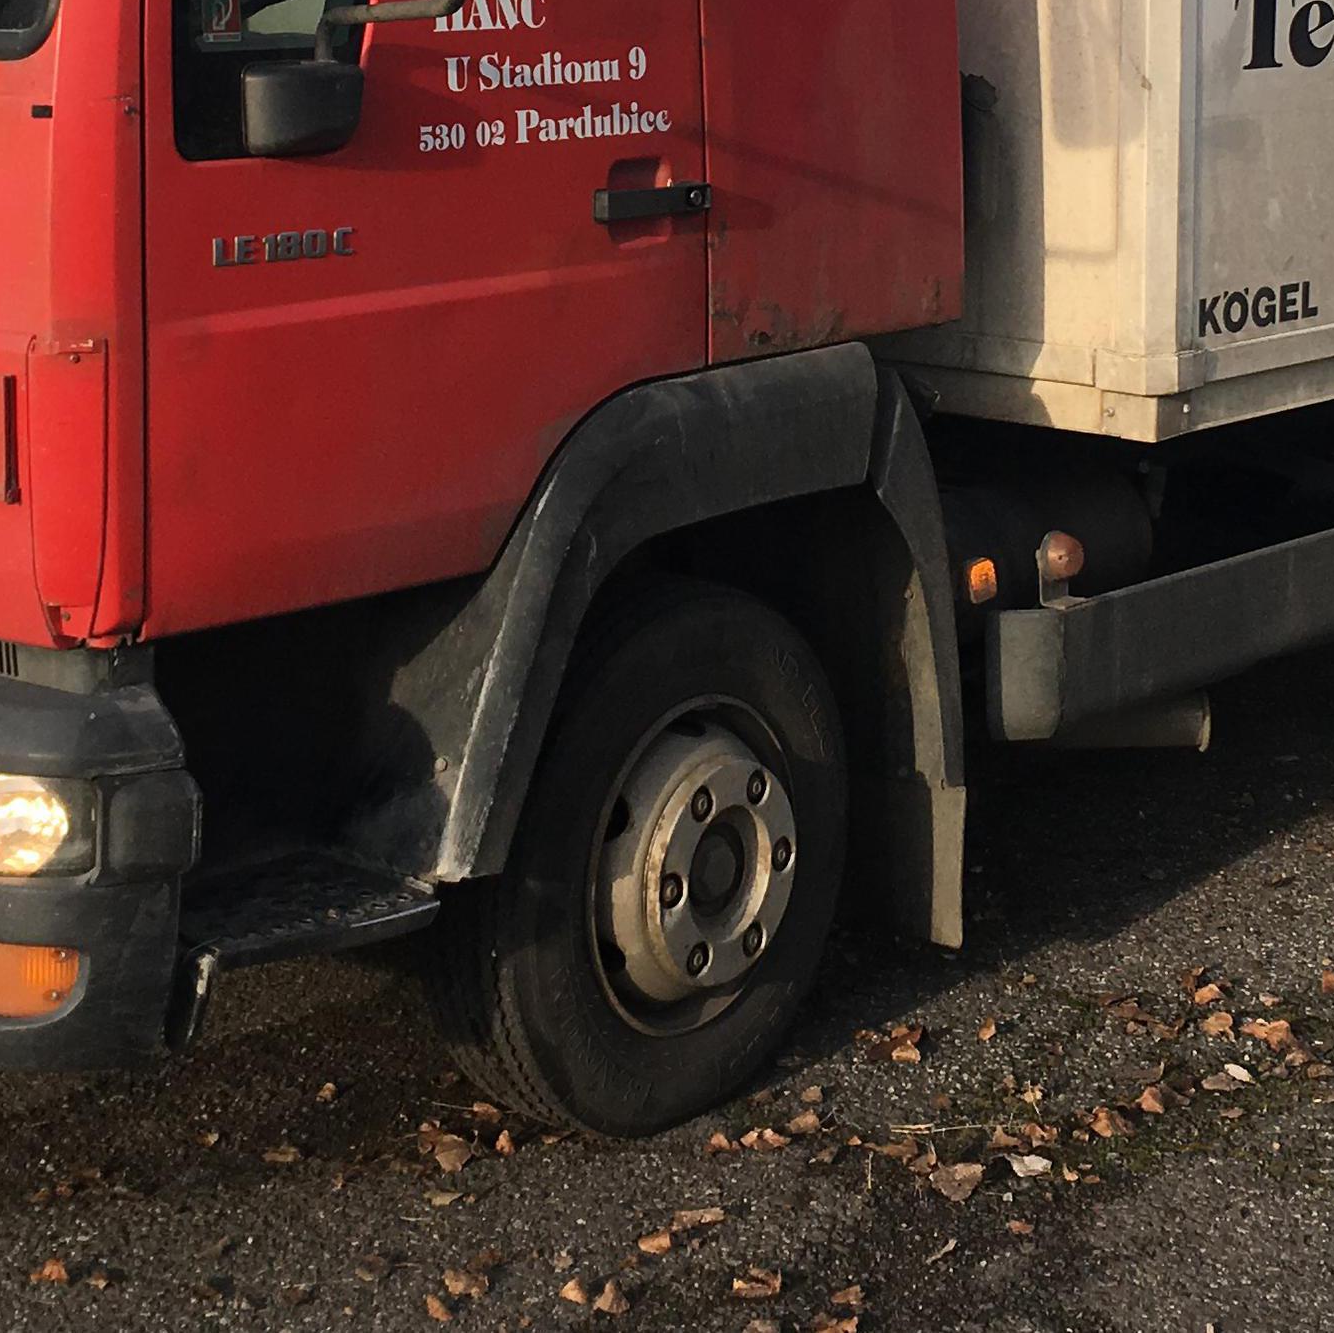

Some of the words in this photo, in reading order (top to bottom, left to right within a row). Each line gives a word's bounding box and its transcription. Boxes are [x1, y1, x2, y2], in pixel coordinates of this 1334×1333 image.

[444, 56, 471, 92] U
[478, 51, 620, 92] Stadionu
[628, 46, 647, 81] 9
[419, 122, 465, 153] 530
[475, 121, 506, 148] 02
[515, 101, 672, 145] Pardubice
[212, 234, 256, 267] LE
[262, 229, 327, 262] 180
[1198, 281, 1318, 337] KÖGEL
